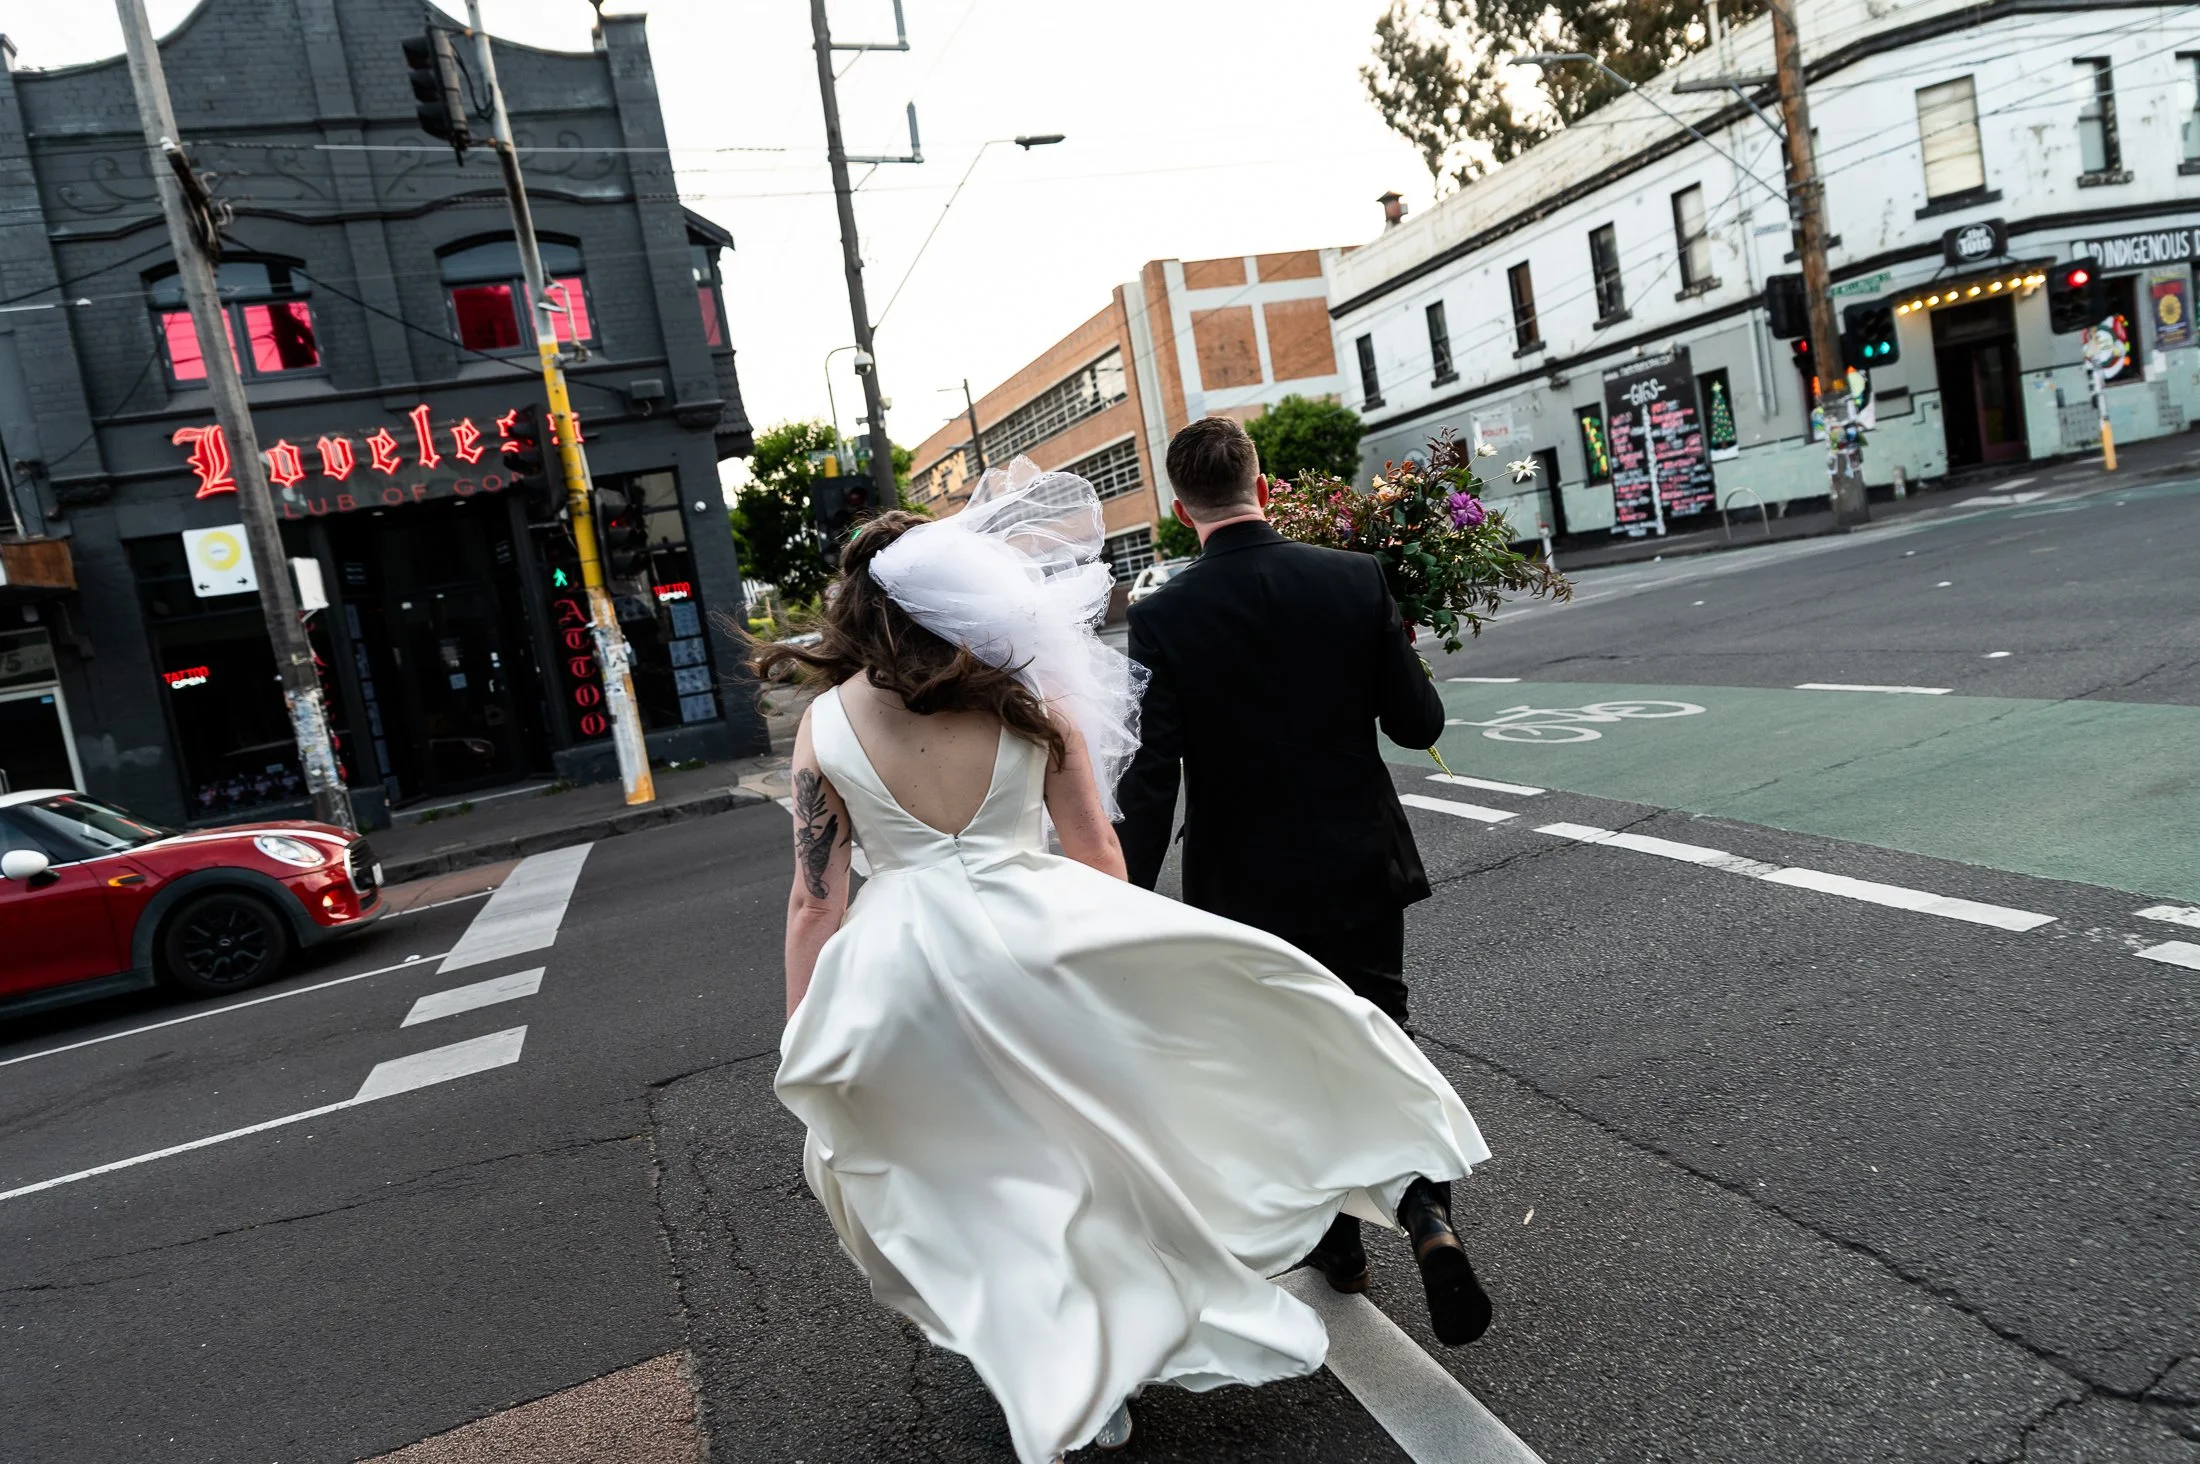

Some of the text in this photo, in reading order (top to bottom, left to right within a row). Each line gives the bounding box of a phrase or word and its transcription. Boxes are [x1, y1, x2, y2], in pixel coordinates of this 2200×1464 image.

[2104, 231, 2191, 269] INDIGENOUS
[382, 484, 428, 506] OF
[653, 582, 691, 597] TATTOO
[554, 580, 606, 736] ATTOO
[163, 666, 209, 685] TATTOO
